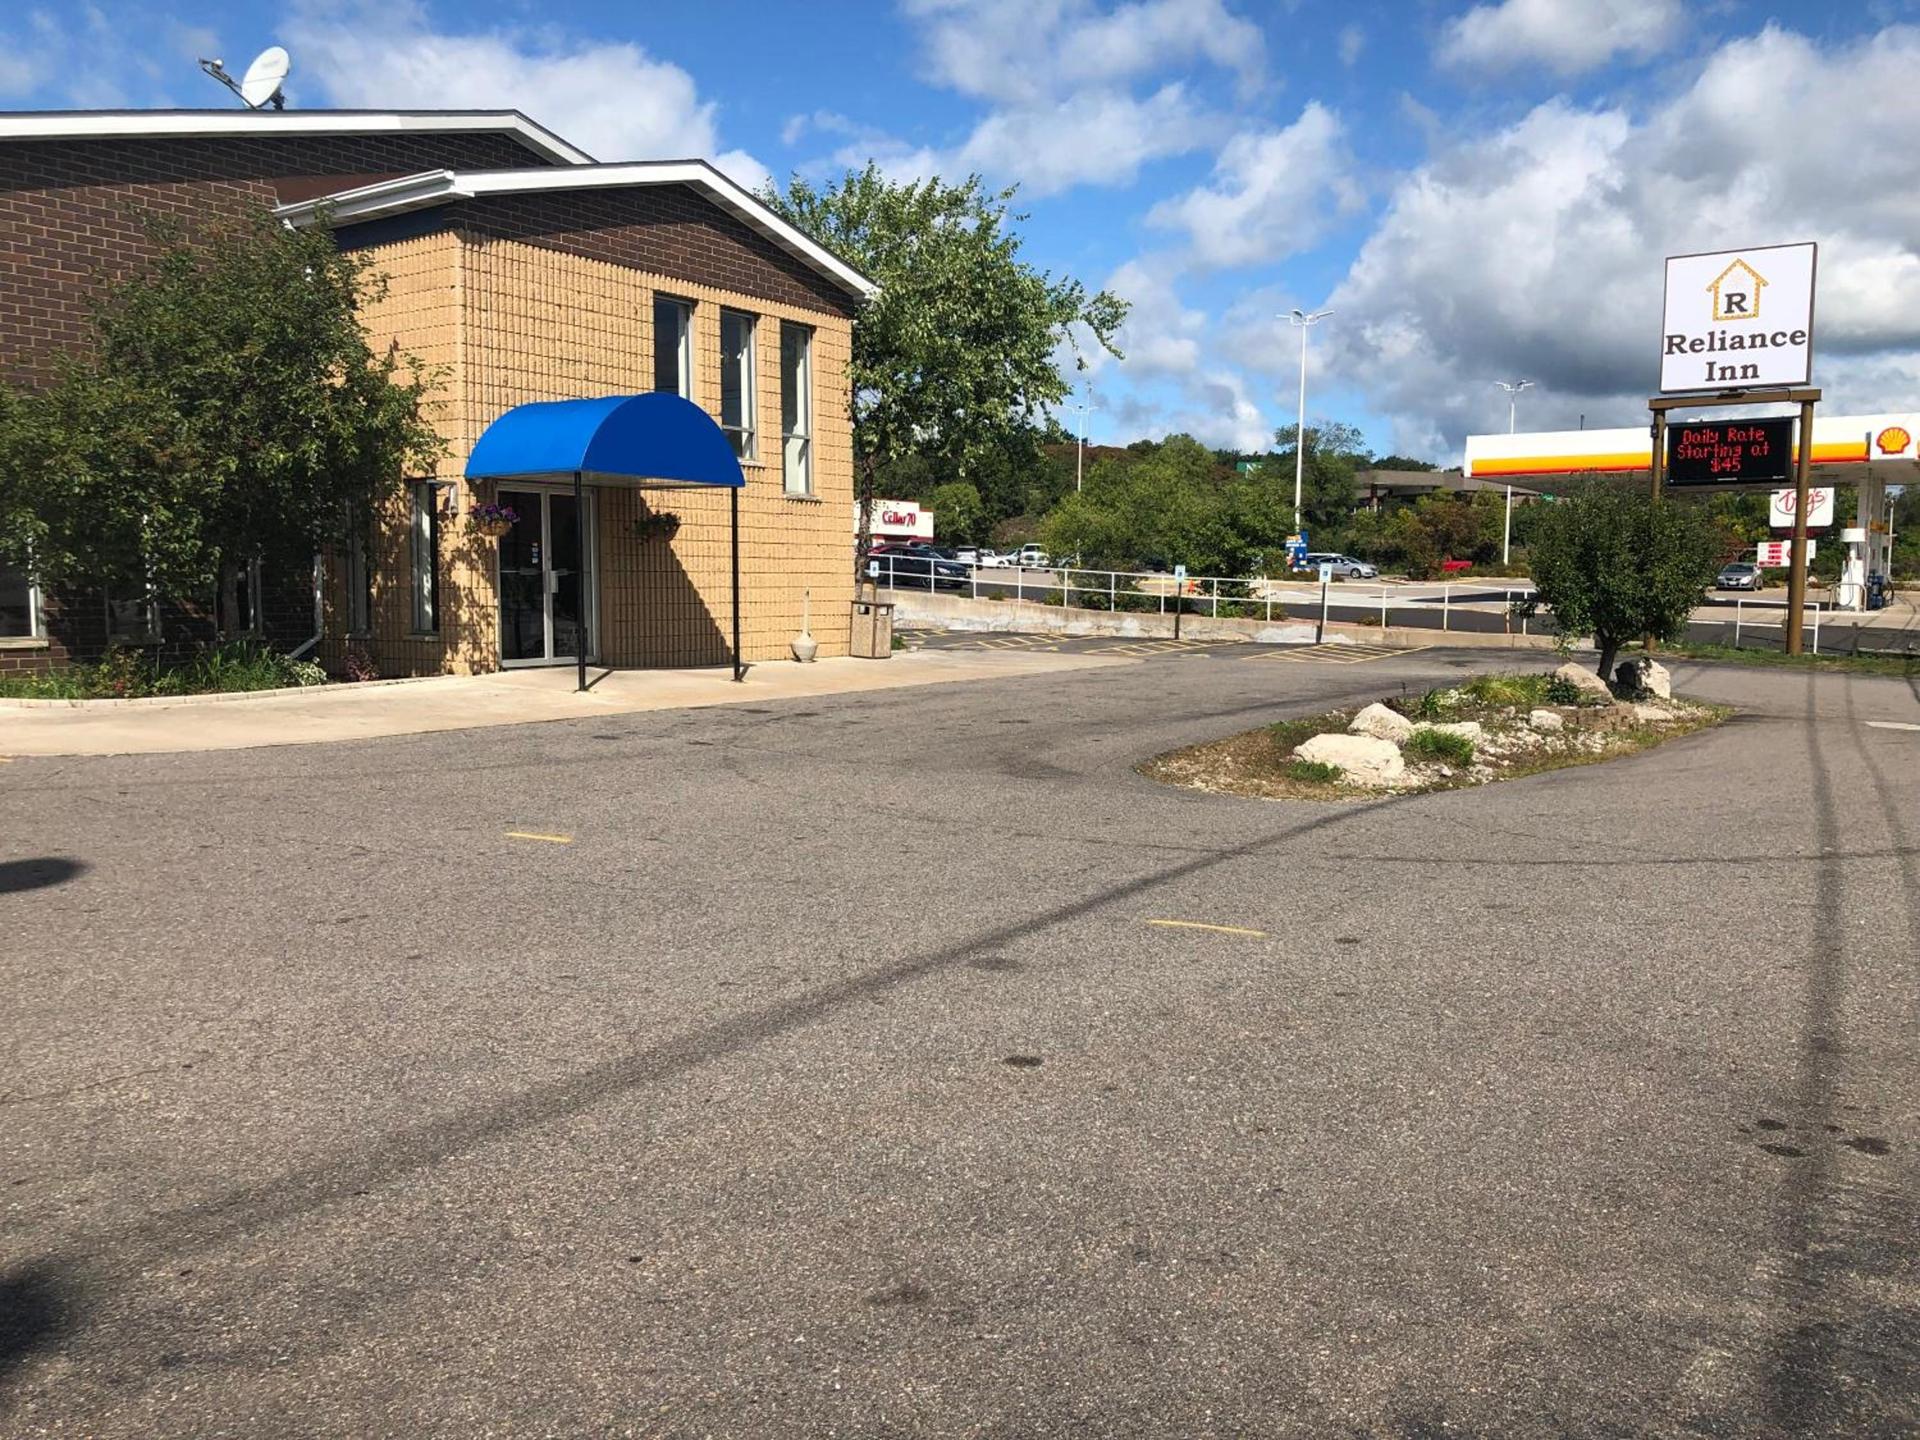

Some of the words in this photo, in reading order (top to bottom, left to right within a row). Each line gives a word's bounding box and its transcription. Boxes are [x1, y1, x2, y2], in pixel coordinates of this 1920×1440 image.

[1724, 293, 1748, 314] R
[1665, 330, 1807, 355] Reliance
[1705, 361, 1760, 382] Inn
[1683, 428, 1719, 444] Daily
[1727, 427, 1765, 442] Rate
[1677, 443, 1742, 459] Starting
[1751, 441, 1770, 456] at
[1711, 458, 1741, 472] $45
